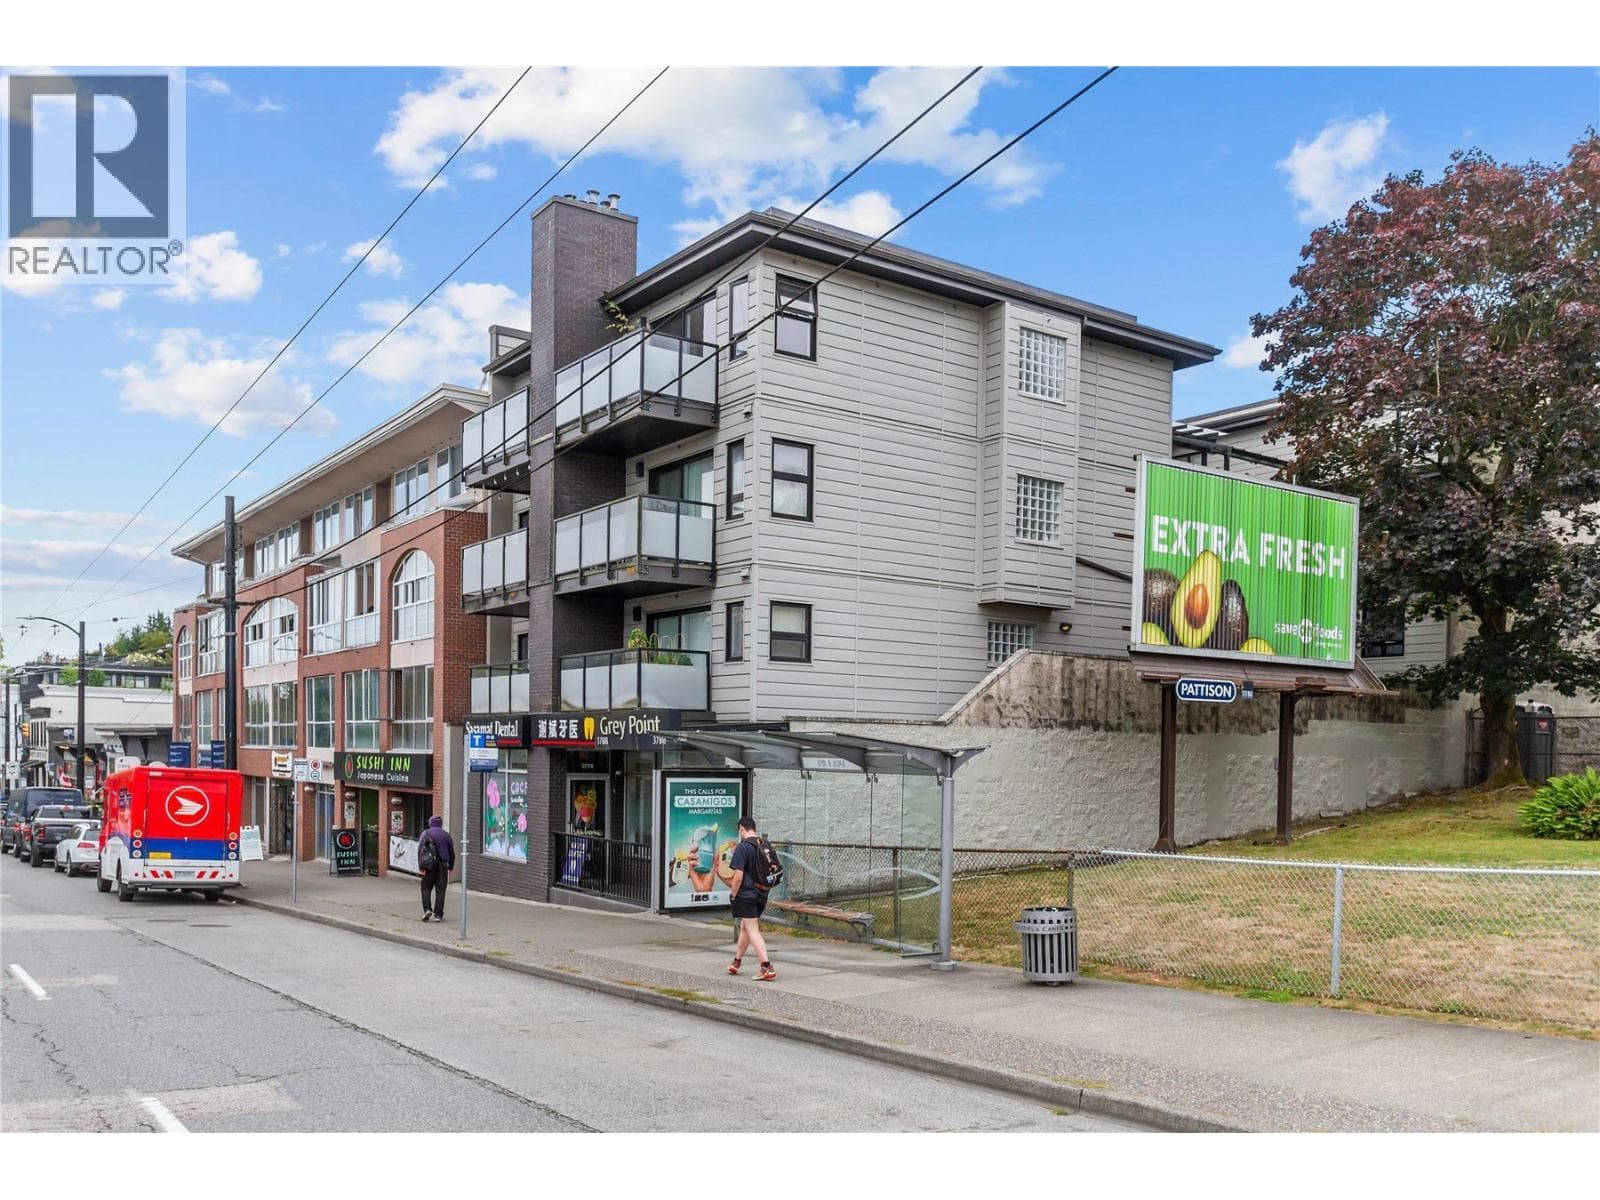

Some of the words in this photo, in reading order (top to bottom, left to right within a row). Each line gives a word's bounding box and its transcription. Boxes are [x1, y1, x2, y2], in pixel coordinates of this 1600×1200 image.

[1152, 515, 1250, 565] EXTRA
[1259, 532, 1346, 580] FRESH
[1181, 682, 1232, 698] PATTISON
[495, 720, 519, 737] Dental
[599, 716, 626, 740] Grey
[628, 714, 660, 735] Point
[356, 755, 384, 771] SUSHI
[390, 756, 411, 772] INN
[357, 771, 384, 781] Japanese
[386, 772, 409, 783] Cuisine
[677, 797, 733, 807] CASAMIGOS
